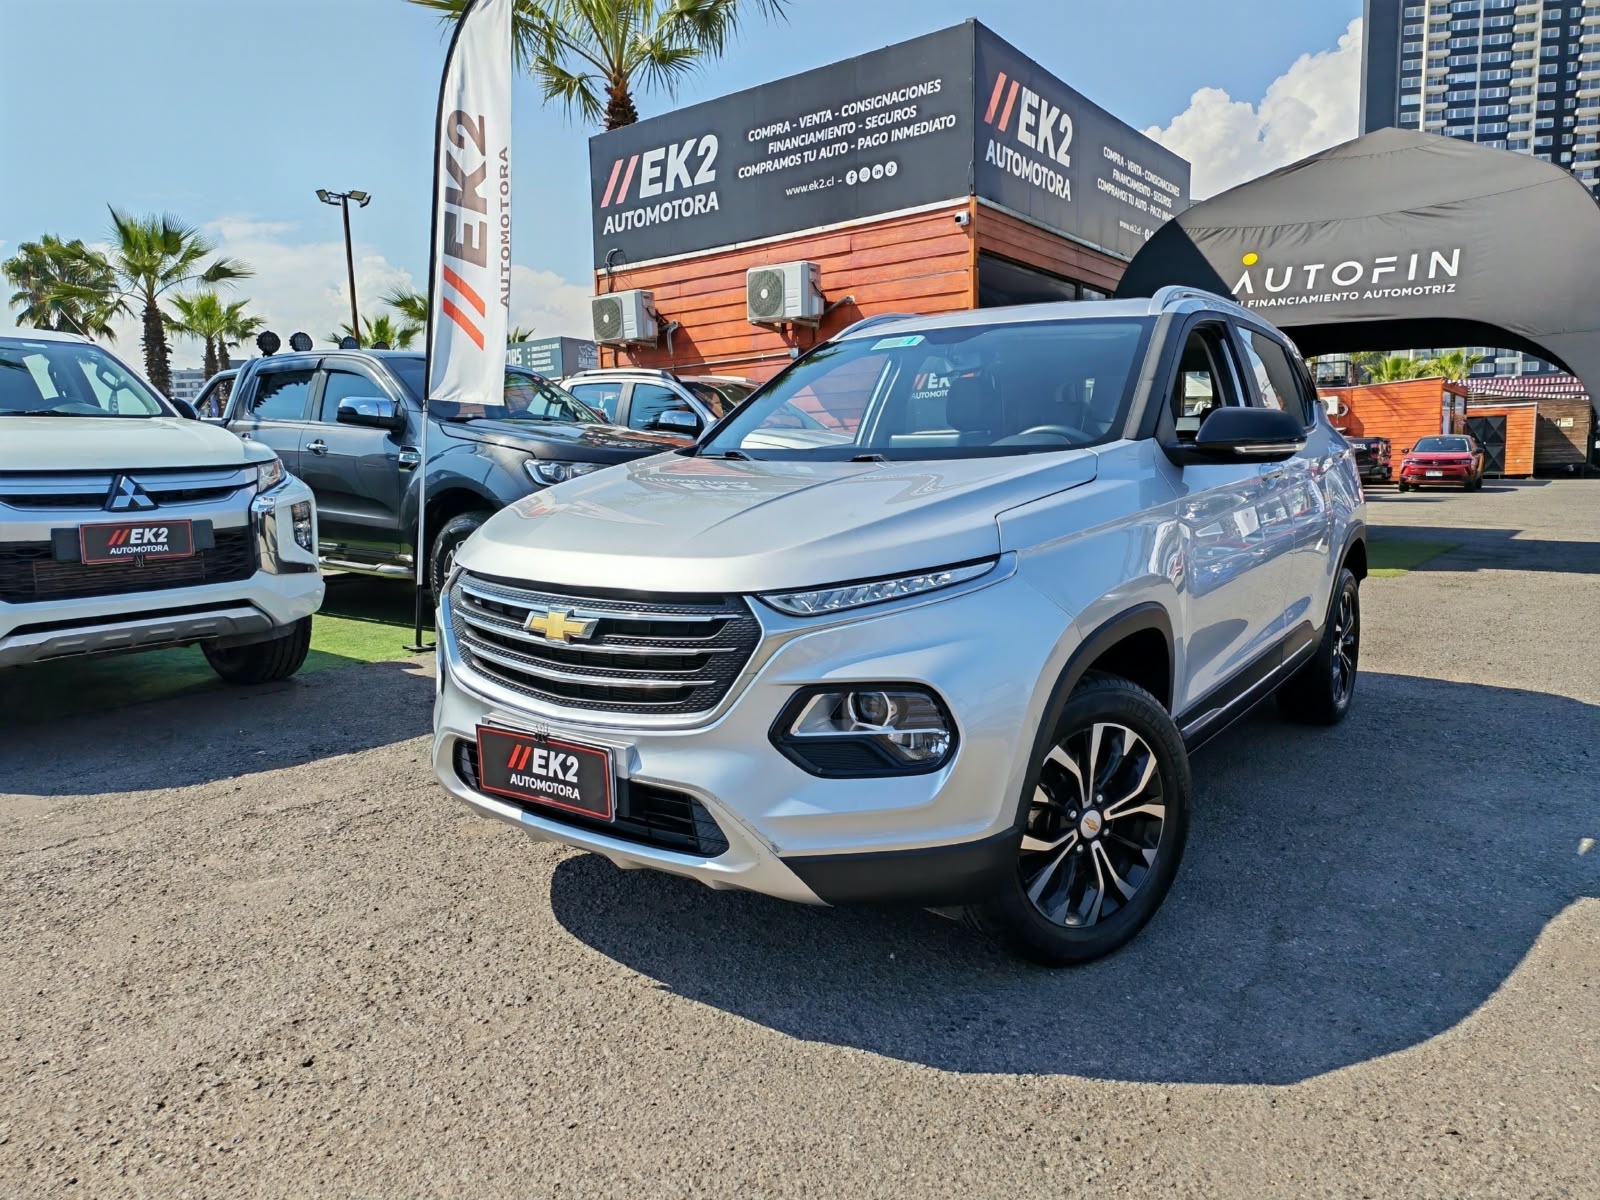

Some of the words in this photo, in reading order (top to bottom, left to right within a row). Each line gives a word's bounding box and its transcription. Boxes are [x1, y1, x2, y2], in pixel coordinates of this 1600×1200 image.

[748, 121, 791, 142] COMPRA
[799, 109, 832, 129] VENTA
[841, 79, 942, 117] CONSIGNACIONES
[768, 121, 856, 154] FINANCIAMIENTO
[865, 105, 917, 129] SEGUROS
[738, 153, 801, 179] COMPRAMOS
[802, 149, 817, 164] TU
[818, 141, 849, 160] AUTO
[857, 131, 889, 150] PAGO
[890, 114, 956, 142] INMEDIATO
[1103, 146, 1125, 167] COMPRA
[1127, 160, 1142, 177] VENTA
[785, 176, 835, 196] www.ek2.cl
[985, 138, 1072, 202] AUTOMOTORA
[602, 190, 719, 235] AUTOMOTORA
[1097, 178, 1128, 203] COMPRAMOS
[1128, 193, 1135, 206] TU
[1134, 197, 1147, 212] AUTO
[1149, 204, 1161, 219] PAGO
[1153, 190, 1172, 208] SEGUROS
[498, 146, 512, 308] AUTOMOTORA
[1231, 248, 1461, 295] AUTOFIN
[1247, 291, 1359, 309] FINANCIAMIENTO
[1363, 283, 1456, 299] AUTOMOTRIZ
[110, 544, 169, 555] AUTOMOTORA
[510, 773, 581, 800] AUTOMOTORA
